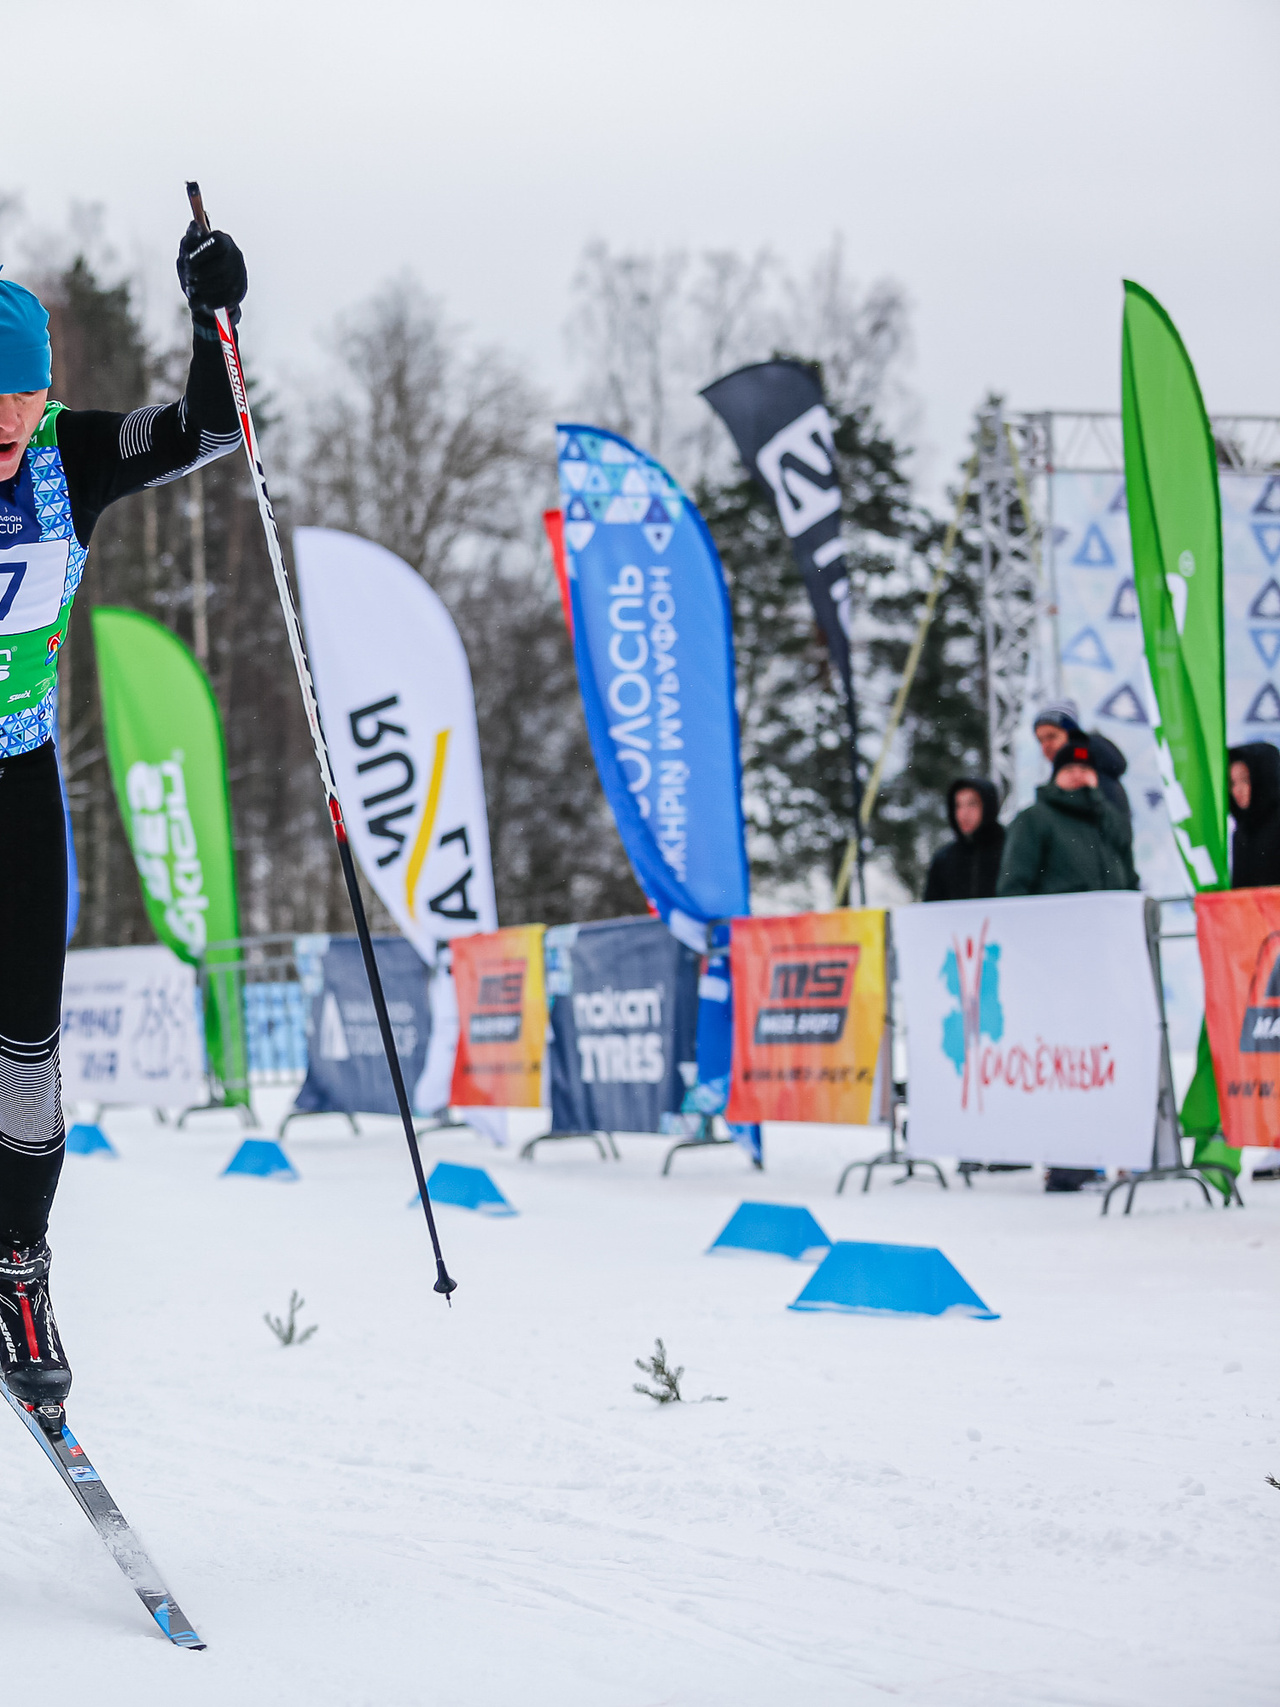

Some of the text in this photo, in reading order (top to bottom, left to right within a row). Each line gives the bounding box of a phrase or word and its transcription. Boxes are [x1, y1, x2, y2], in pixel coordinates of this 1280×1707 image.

[221, 339, 248, 416] MADSHUS
[771, 961, 848, 999] MS
[578, 1032, 665, 1084] TYRES
